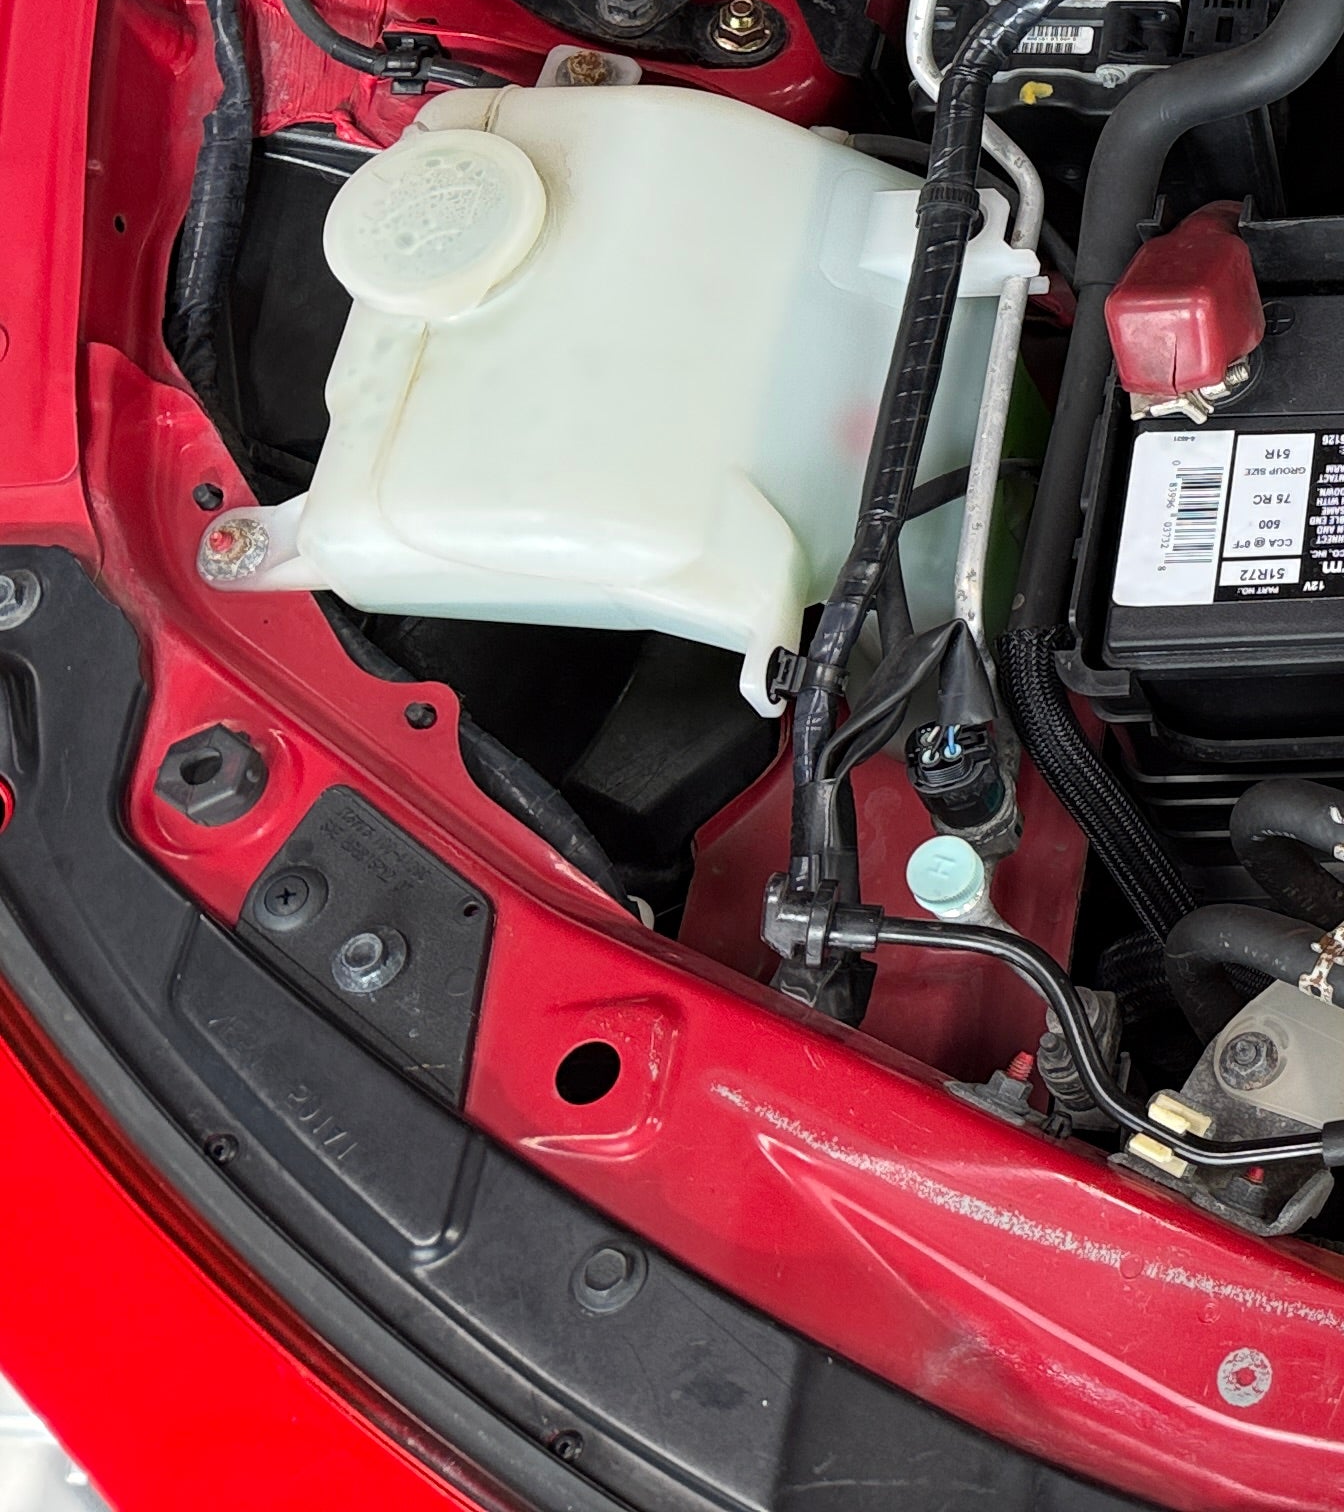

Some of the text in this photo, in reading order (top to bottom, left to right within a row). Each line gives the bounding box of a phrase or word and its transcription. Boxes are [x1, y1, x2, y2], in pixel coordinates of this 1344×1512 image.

[1265, 448, 1291, 460] 51R
[1244, 466, 1306, 476] GROUP SIZE
[1166, 482, 1177, 509] 83996
[1253, 493, 1291, 505] 75 RC
[1316, 497, 1339, 506] WITH
[1258, 519, 1280, 530] 500
[1310, 516, 1327, 525] END
[1160, 521, 1170, 549] 03732
[1317, 525, 1335, 534] AND
[1253, 536, 1265, 548] @
[1269, 538, 1293, 548] CCA
[1310, 549, 1326, 558] INC.
[1240, 568, 1285, 581] 51R72
[1257, 586, 1279, 594] PART
[1303, 580, 1325, 591] 12V
